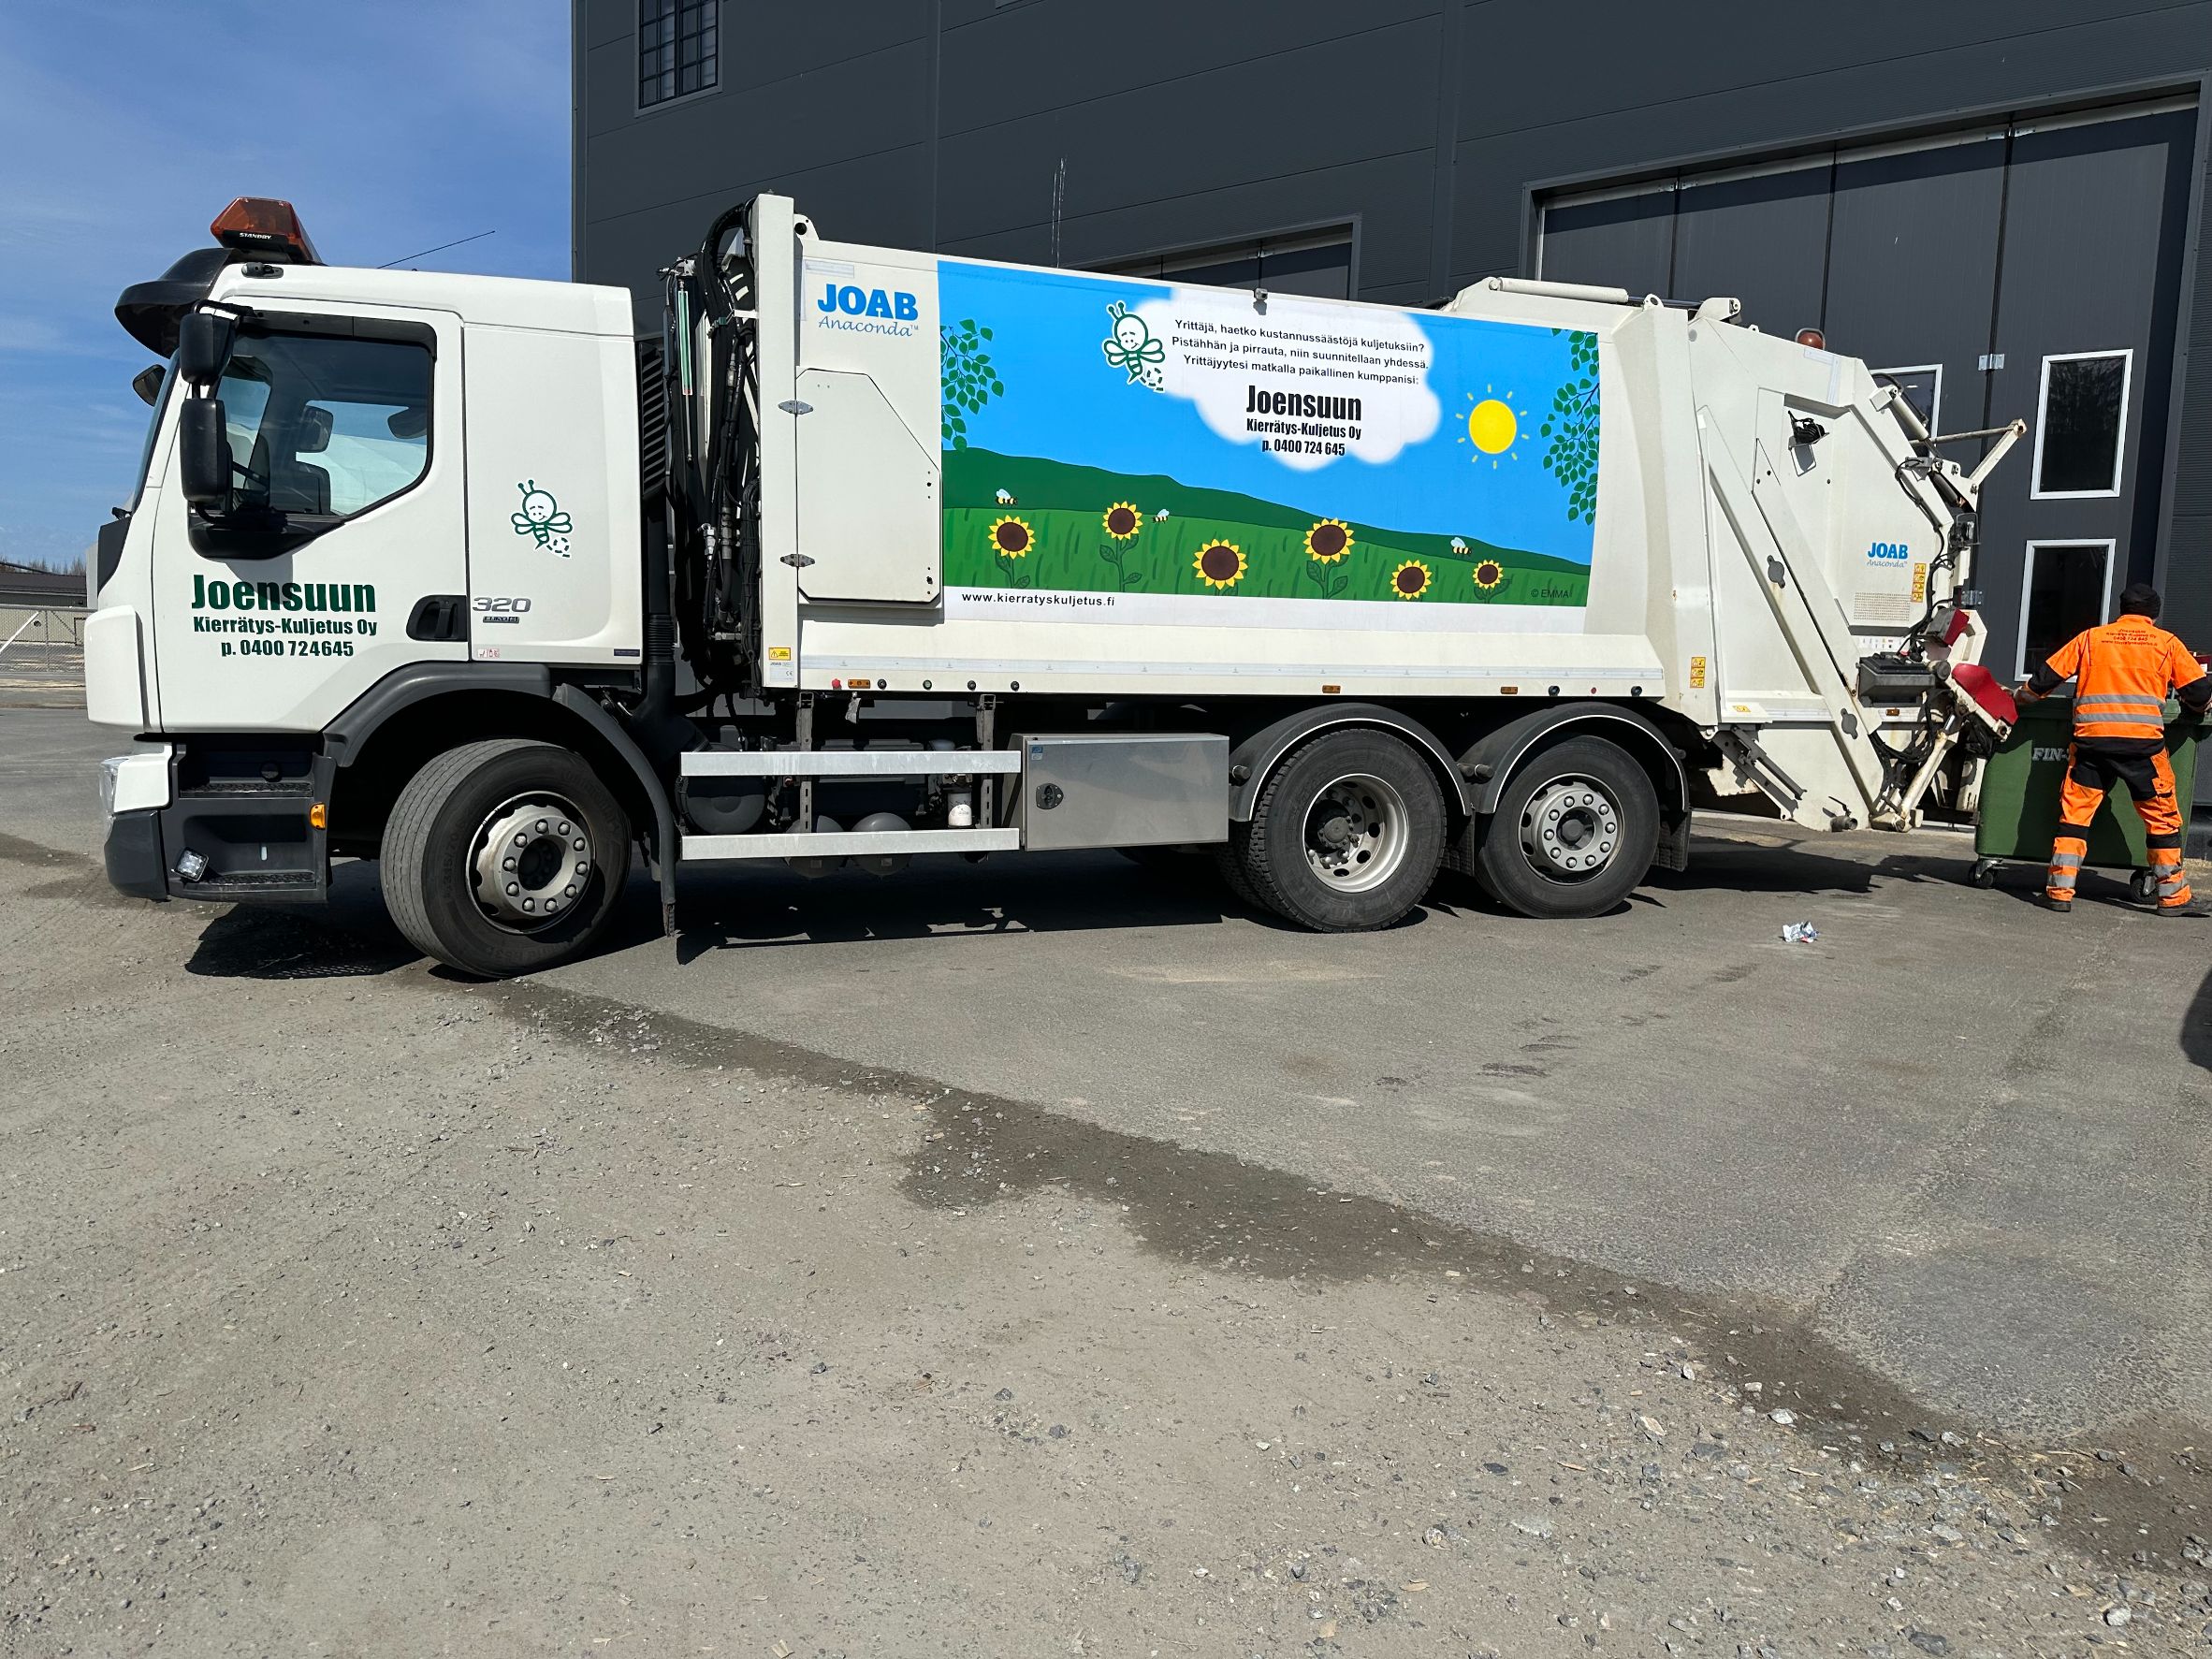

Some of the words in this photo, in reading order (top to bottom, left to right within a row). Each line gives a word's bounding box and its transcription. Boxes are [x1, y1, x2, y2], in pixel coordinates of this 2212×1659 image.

[818, 284, 918, 321] JOAB
[1175, 319, 1216, 333] Yrittäjä,
[1220, 324, 1257, 337] haetko
[1259, 328, 1358, 347] kustannussäästöjä
[1361, 338, 1424, 352] kuljetuksiin?
[1171, 337, 1226, 350] Pistähhän
[1230, 342, 1239, 353] ja
[1243, 344, 1287, 357] pirrauta,
[1290, 349, 1309, 357] niin
[1312, 352, 1381, 365] suunnitellaan
[1384, 357, 1428, 369] yhdessä.
[1184, 355, 1248, 370] Yrittäjyytesi
[1252, 362, 1295, 373] matkalla
[1299, 367, 1354, 379] paikallinen
[1358, 371, 1419, 385] kumppanisi:
[1246, 386, 1361, 421] Joensuun
[1246, 418, 1346, 437] Kierrätys-Kuljetus
[1349, 426, 1361, 440] Oy
[1262, 440, 1272, 452] p.
[1274, 439, 1302, 453] 0400
[1304, 441, 1322, 454] 724
[1325, 442, 1345, 456] 645
[1868, 543, 1908, 560] JOAB
[192, 575, 376, 612] Joensuun
[962, 593, 1114, 606] www.kierratyskuljetus.fi
[1541, 589, 1568, 598] EMMA
[473, 597, 531, 612] 320
[194, 617, 353, 635] Kierrätys-Kuljetus
[357, 619, 377, 636] Oy
[221, 642, 236, 657] p.
[240, 640, 284, 656] 0400
[288, 641, 354, 656] 724645
[2032, 748, 2070, 761] FIN-
